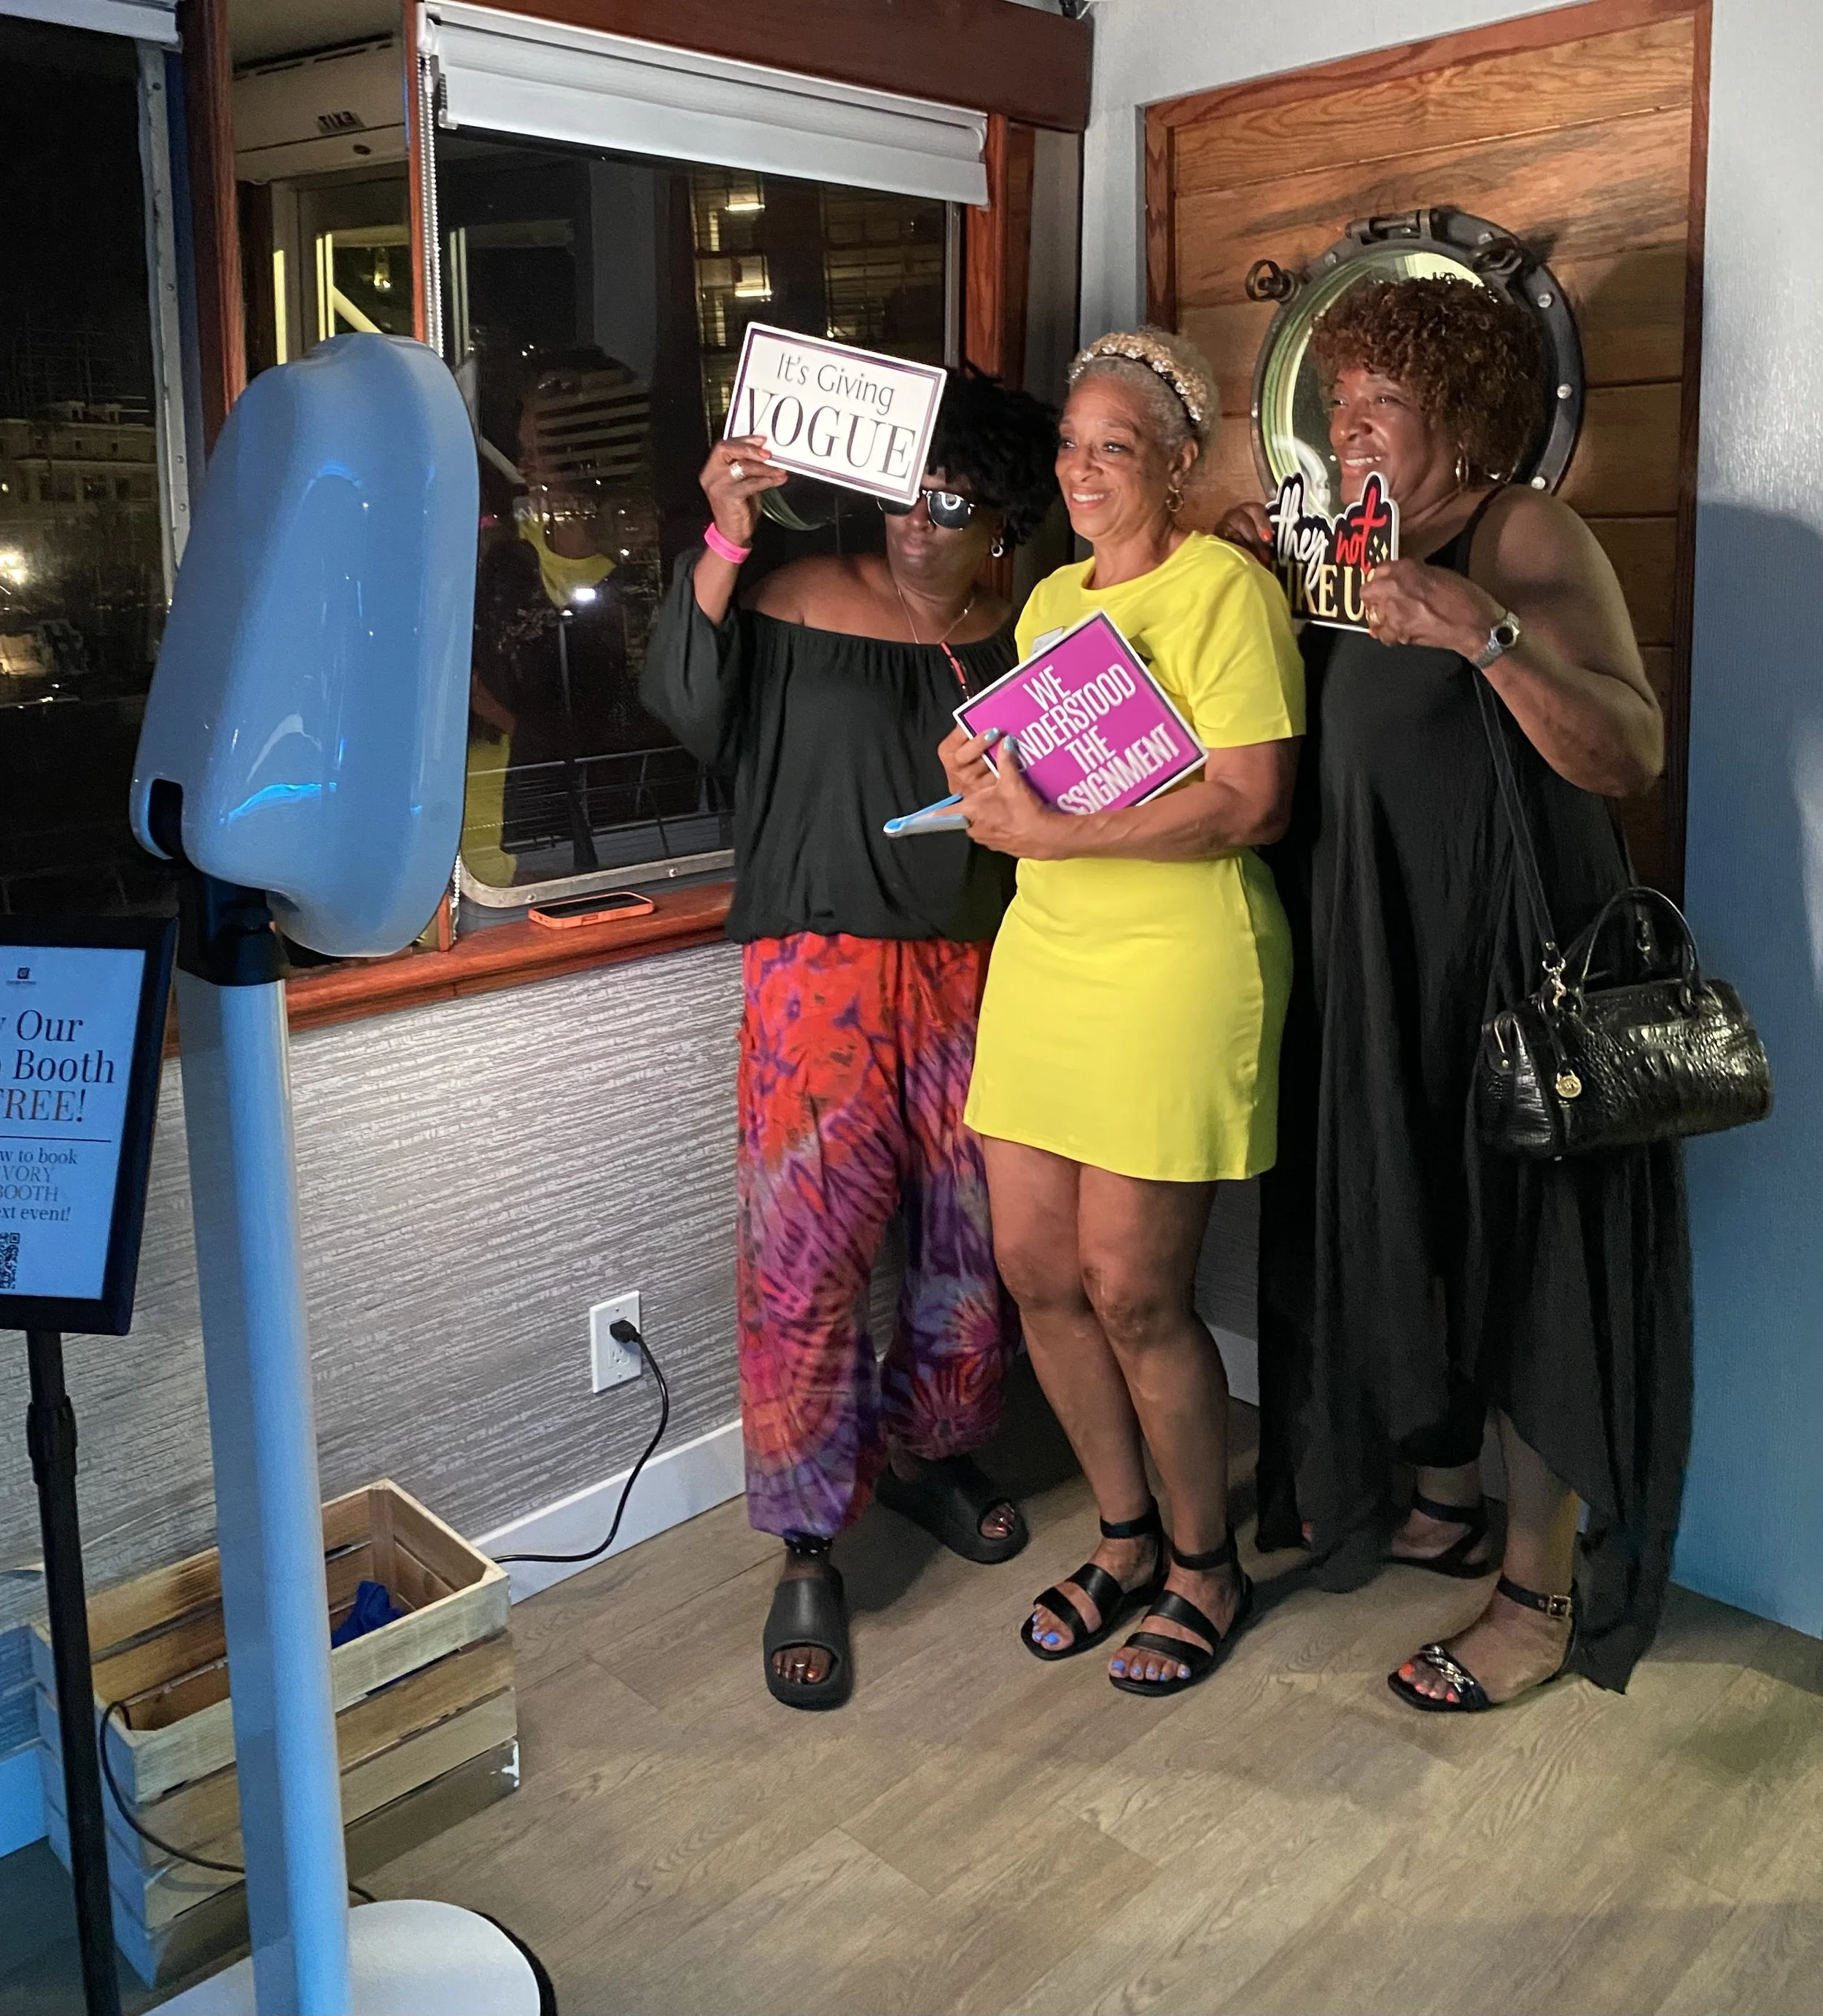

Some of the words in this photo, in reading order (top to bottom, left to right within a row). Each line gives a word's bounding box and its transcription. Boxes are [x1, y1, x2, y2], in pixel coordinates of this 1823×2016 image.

[776, 352, 809, 386] It's
[817, 364, 894, 416] Giving
[745, 384, 916, 480] VOGUE
[1270, 483, 1329, 590] they
[1335, 486, 1388, 575] not
[1272, 560, 1338, 618] IKE
[1022, 664, 1072, 712] WE
[1018, 663, 1137, 771] NDERSTOOD
[1057, 723, 1181, 815] SSIGNMENT
[1064, 725, 1117, 774] THE
[17, 1009, 83, 1041] Our
[12, 1048, 115, 1083] Booth
[0, 1164, 55, 1183] VORY
[18, 1151, 34, 1163] to
[38, 1147, 77, 1164] book
[20, 1206, 71, 1221] event!
